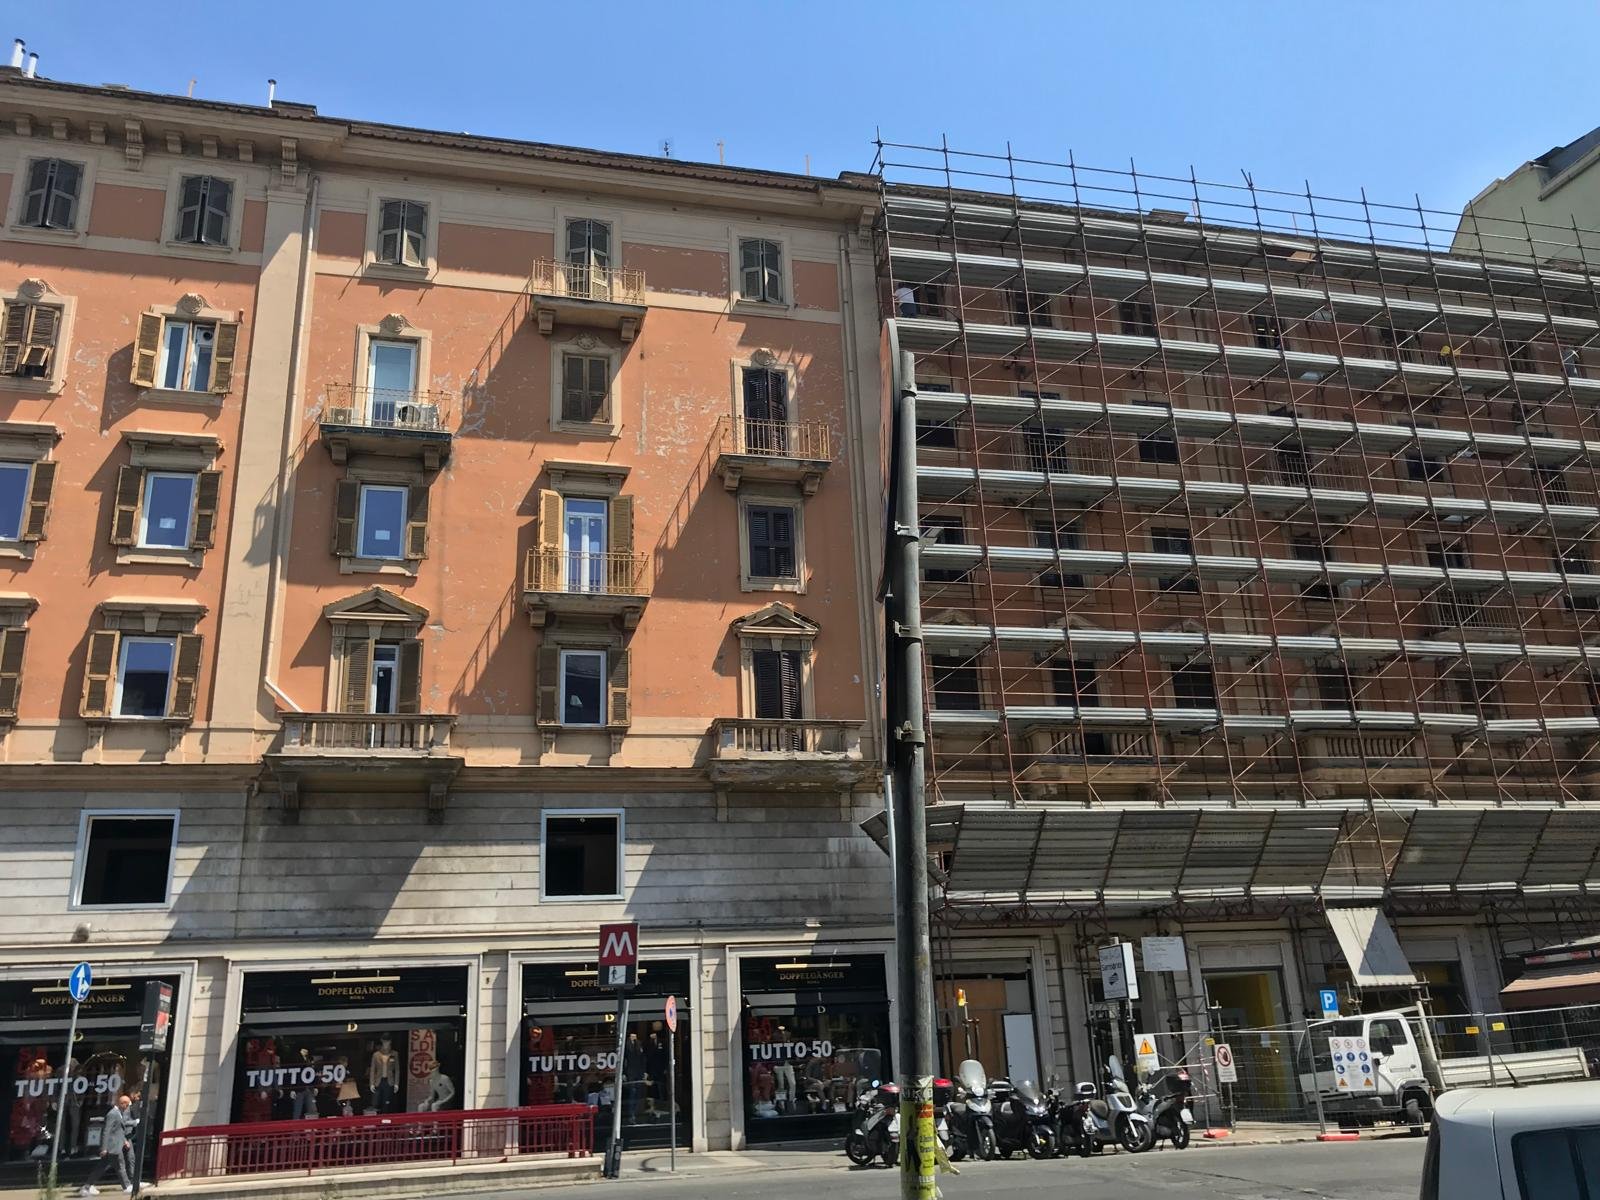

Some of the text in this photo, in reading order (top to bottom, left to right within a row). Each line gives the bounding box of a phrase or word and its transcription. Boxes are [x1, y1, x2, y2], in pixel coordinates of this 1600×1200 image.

[602, 931, 634, 958] M
[817, 1006, 826, 1014] D
[1323, 993, 1333, 1009] P
[347, 1023, 358, 1032] D
[750, 1042, 807, 1060] TUTTO
[529, 1054, 591, 1072] TUTTO
[246, 1066, 316, 1088] TUTTO
